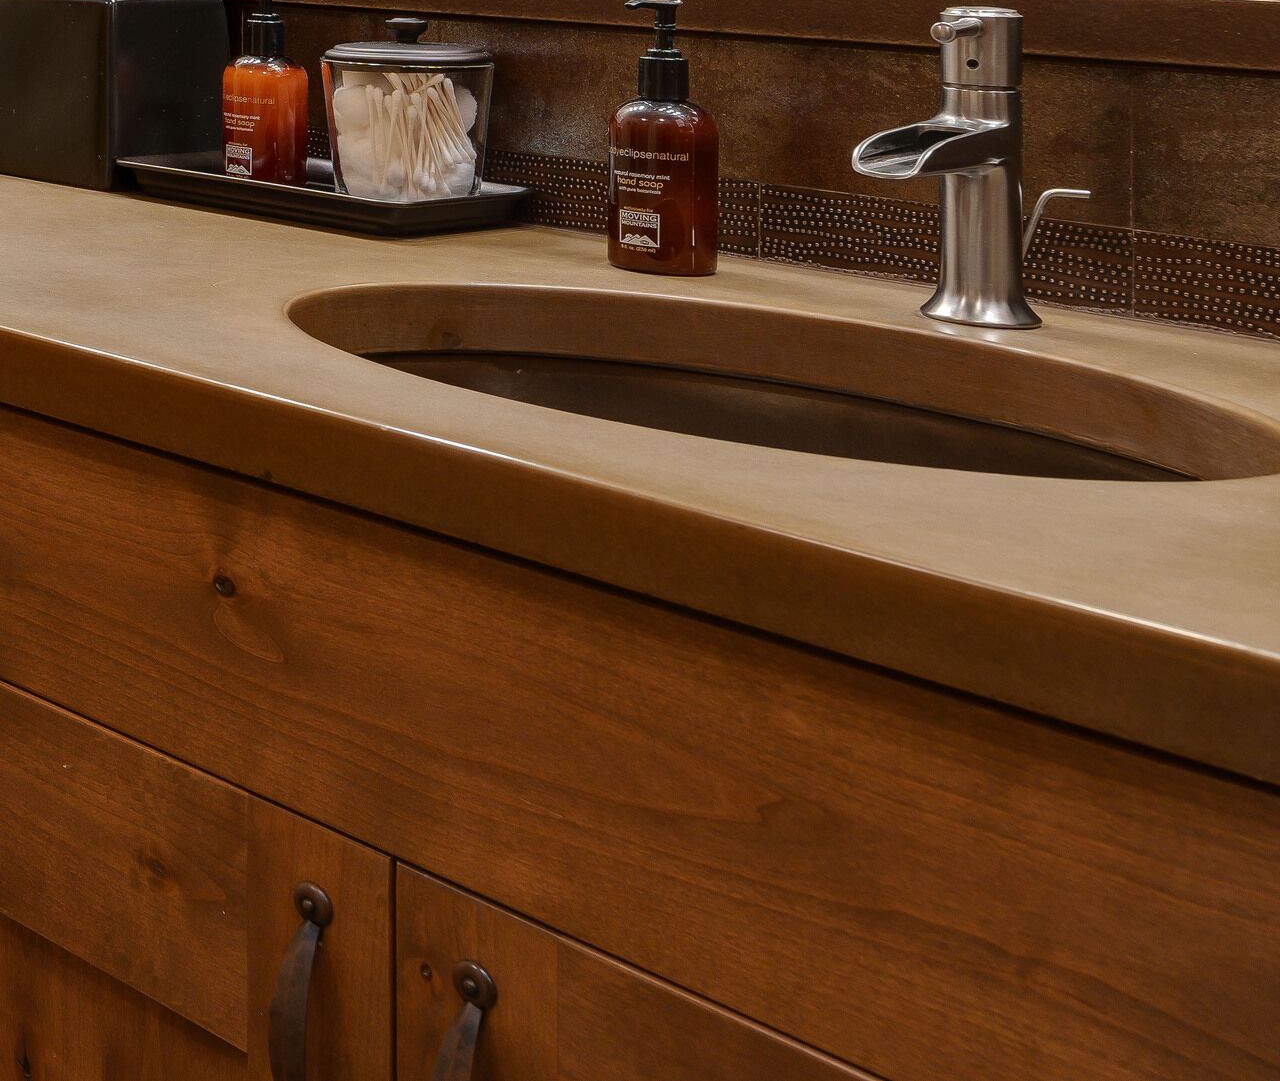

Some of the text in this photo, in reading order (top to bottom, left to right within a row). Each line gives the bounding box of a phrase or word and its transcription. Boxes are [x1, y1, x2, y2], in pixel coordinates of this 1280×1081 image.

[618, 176, 664, 190] hand soap
[621, 212, 657, 222] MOVING
[621, 219, 657, 229] MOUNTAINS
